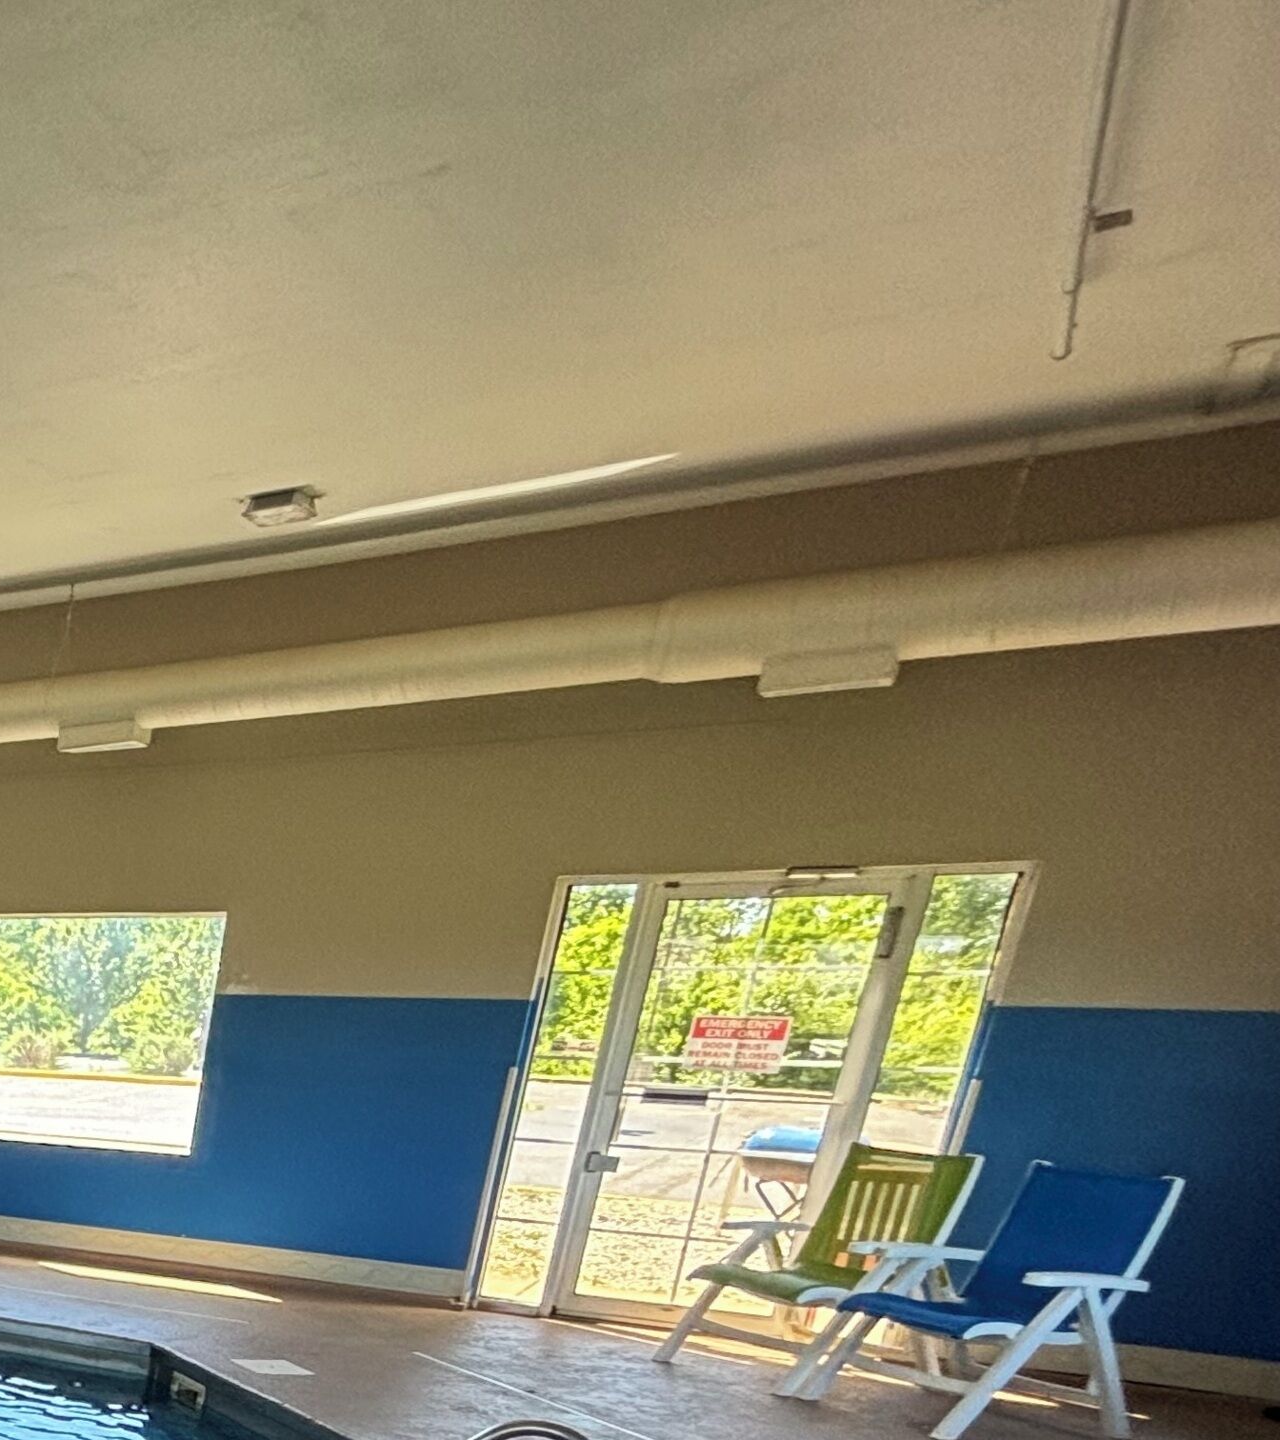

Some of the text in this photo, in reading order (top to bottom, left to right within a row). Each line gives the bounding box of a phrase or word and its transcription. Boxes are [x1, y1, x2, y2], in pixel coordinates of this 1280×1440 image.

[699, 1019, 783, 1029] EMERGENCY
[704, 1028, 773, 1039] EXIT ONLY
[701, 1041, 769, 1051] DOOR MUST
[687, 1050, 779, 1060] REMAIN CLOSED
[692, 1059, 768, 1070] AT ALL TIMES
